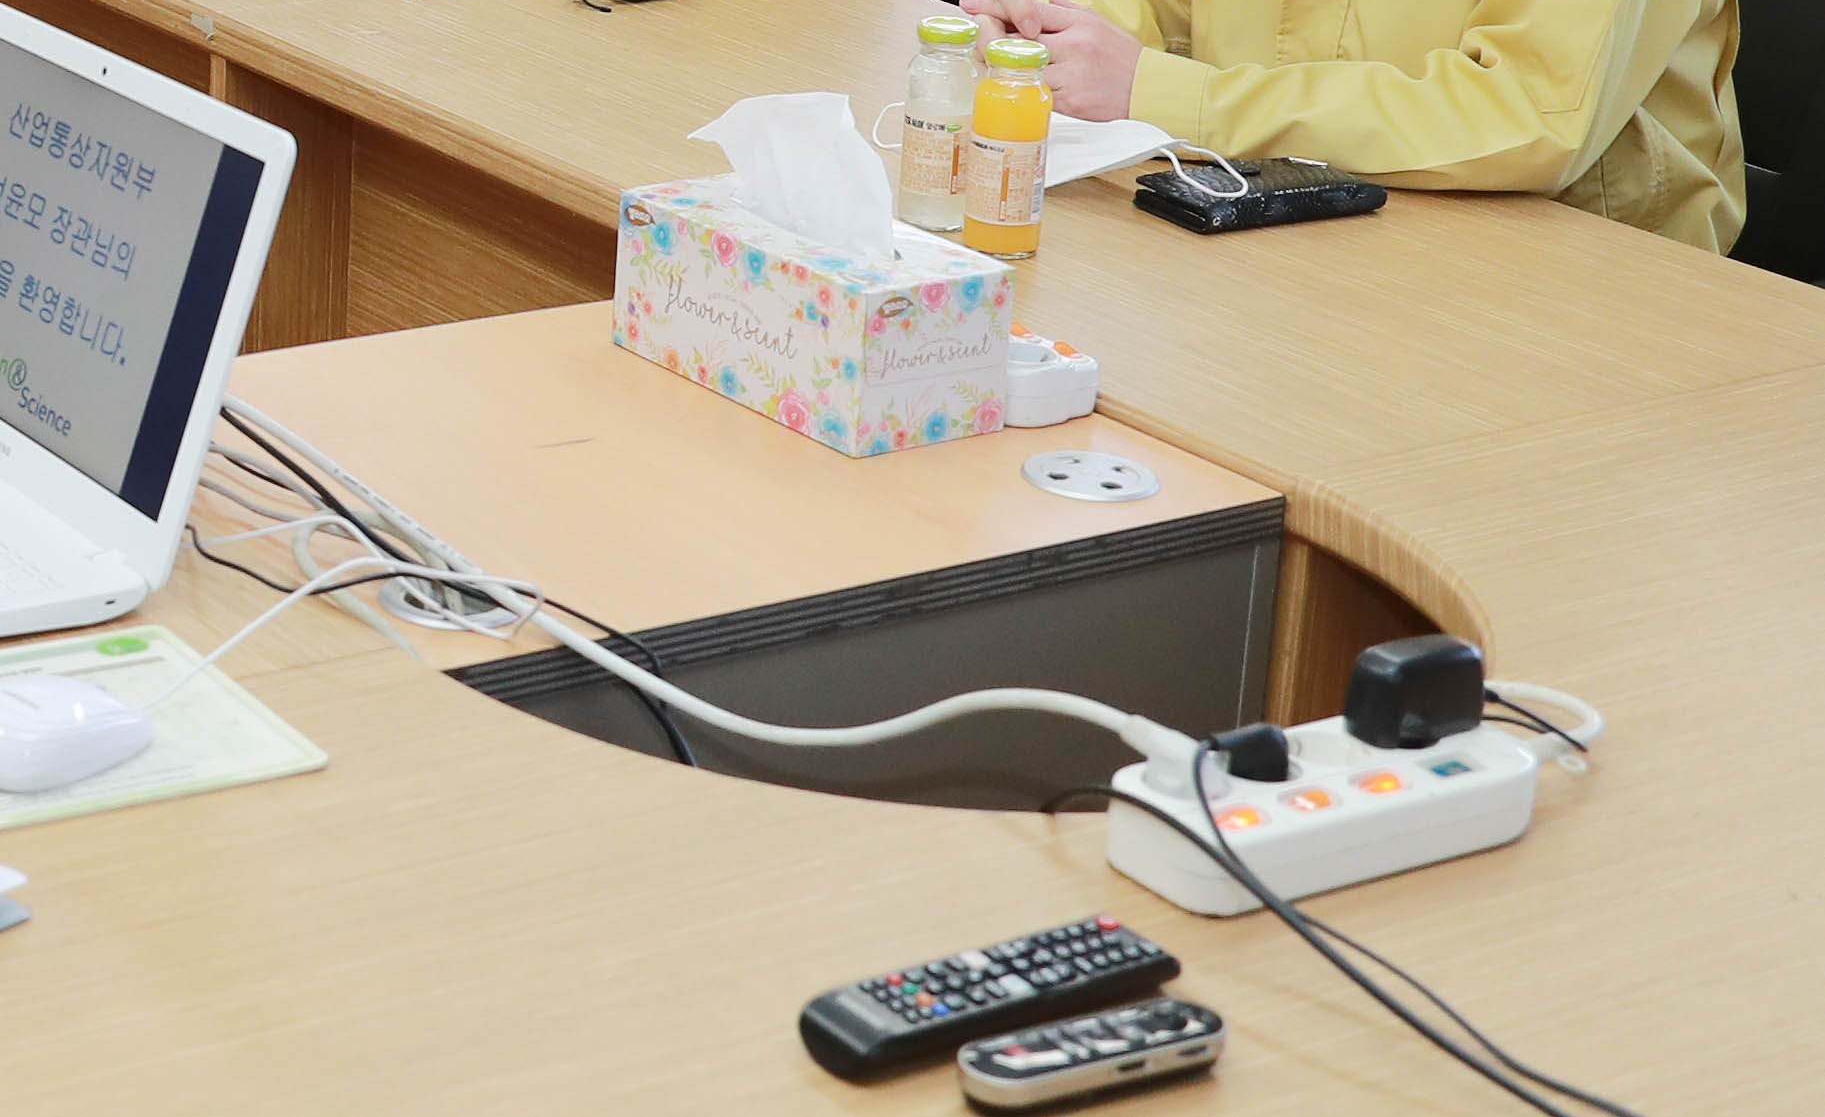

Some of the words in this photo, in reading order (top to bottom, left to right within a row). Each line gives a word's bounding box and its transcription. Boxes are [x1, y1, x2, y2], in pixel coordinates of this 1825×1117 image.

[7, 101, 157, 200] 산업통상자원부
[49, 204, 138, 283] 장관님의
[17, 273, 127, 366] 환영합니다.
[17, 386, 73, 438] Science
